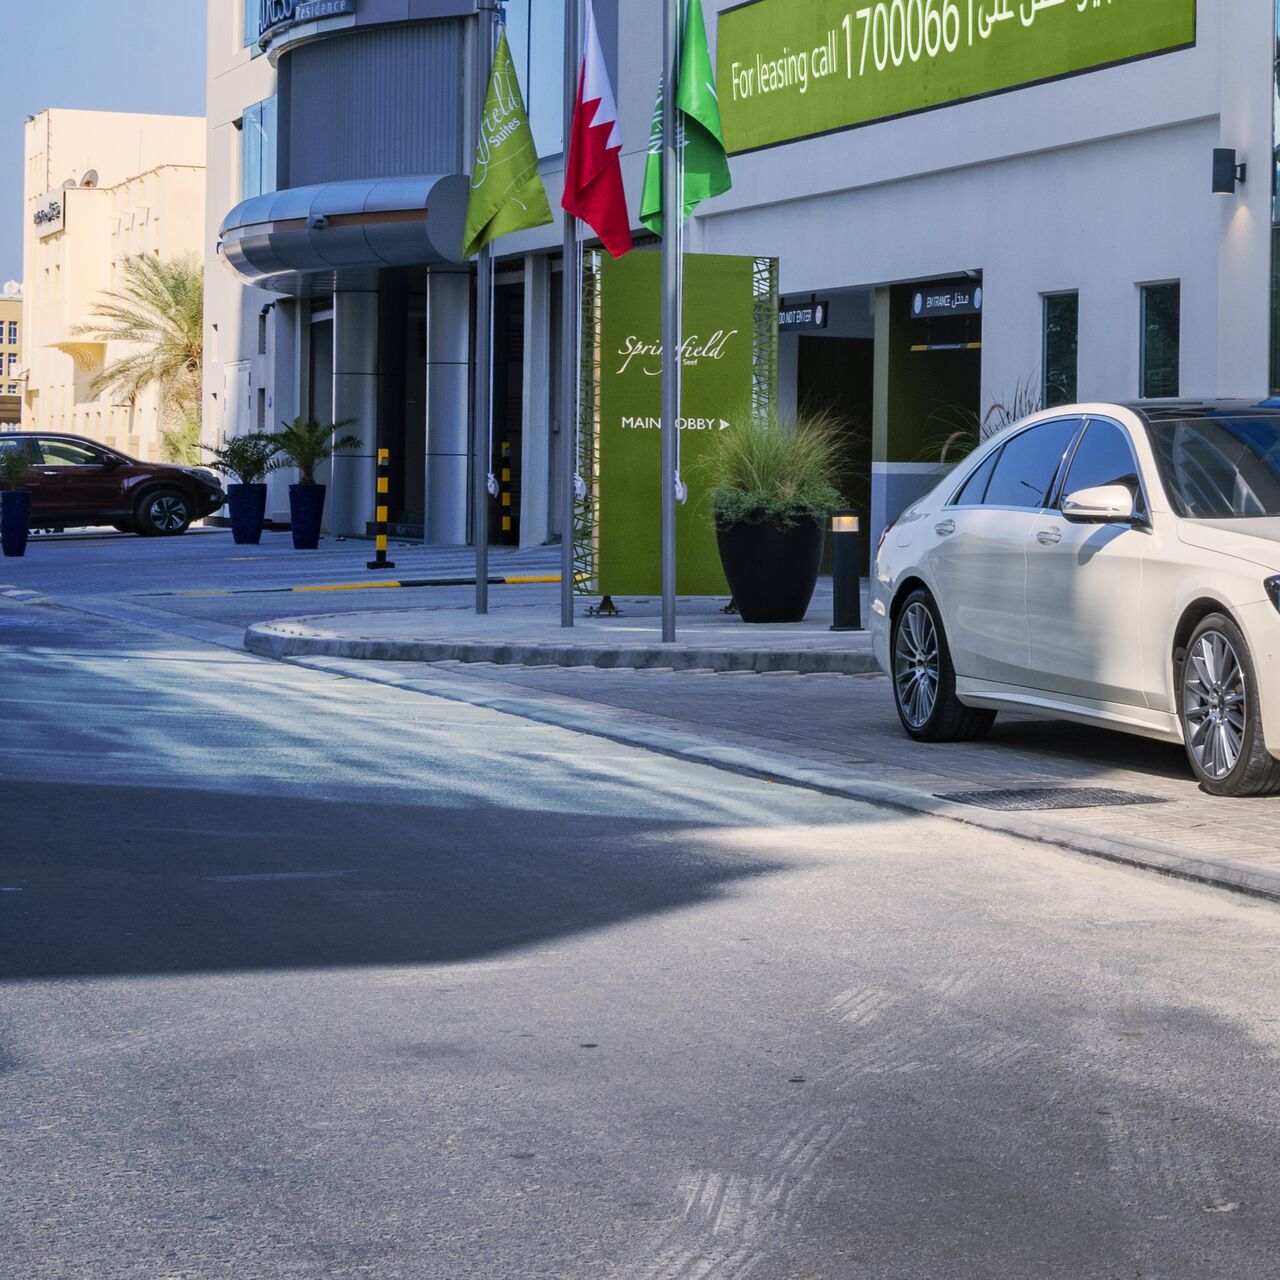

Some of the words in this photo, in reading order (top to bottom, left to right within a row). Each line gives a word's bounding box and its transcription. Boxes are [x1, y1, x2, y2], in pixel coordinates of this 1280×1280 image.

[732, 62, 754, 101] For
[756, 47, 808, 94] leasing
[811, 28, 837, 78] call
[488, 117, 521, 148] Suites
[926, 294, 951, 308] ENTRANCE
[616, 329, 738, 376] Sprifield
[621, 416, 662, 429] MAIN
[673, 418, 716, 430] OBBY
